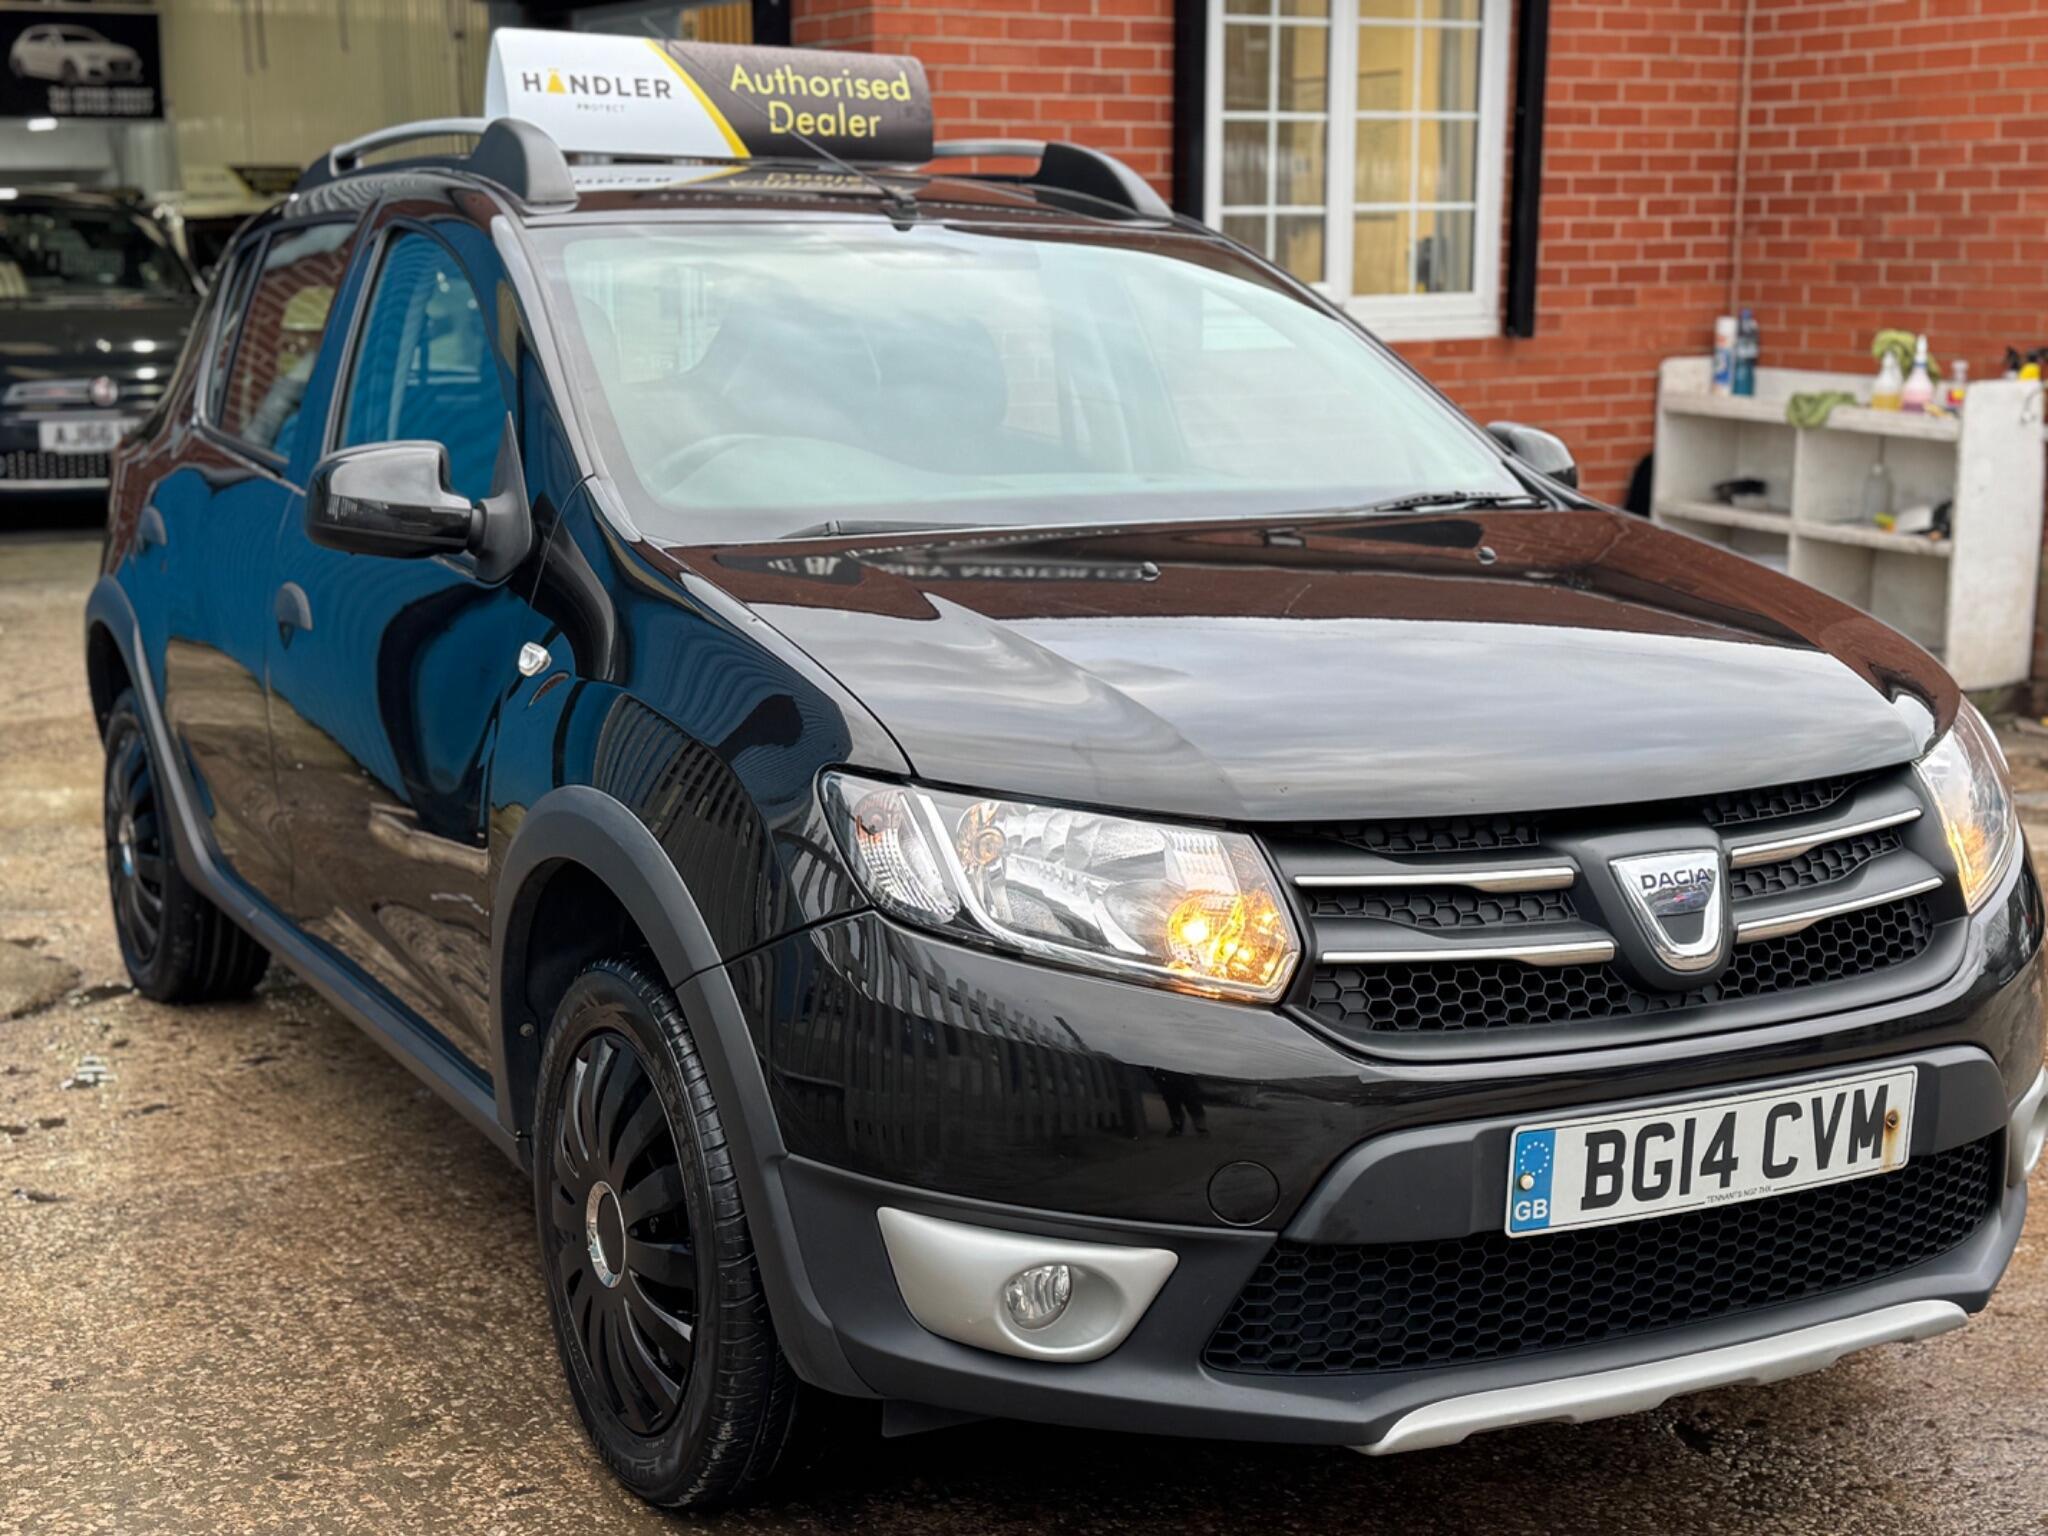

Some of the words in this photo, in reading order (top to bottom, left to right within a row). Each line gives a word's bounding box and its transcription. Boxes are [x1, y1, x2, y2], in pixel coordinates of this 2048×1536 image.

[731, 63, 911, 101] Authorised
[768, 100, 881, 138] Dealer
[1641, 867, 1712, 890] DACIA
[1580, 1111, 1738, 1211] BG14
[1763, 1084, 1889, 1179] CVM
[1514, 1198, 1549, 1222] GB
